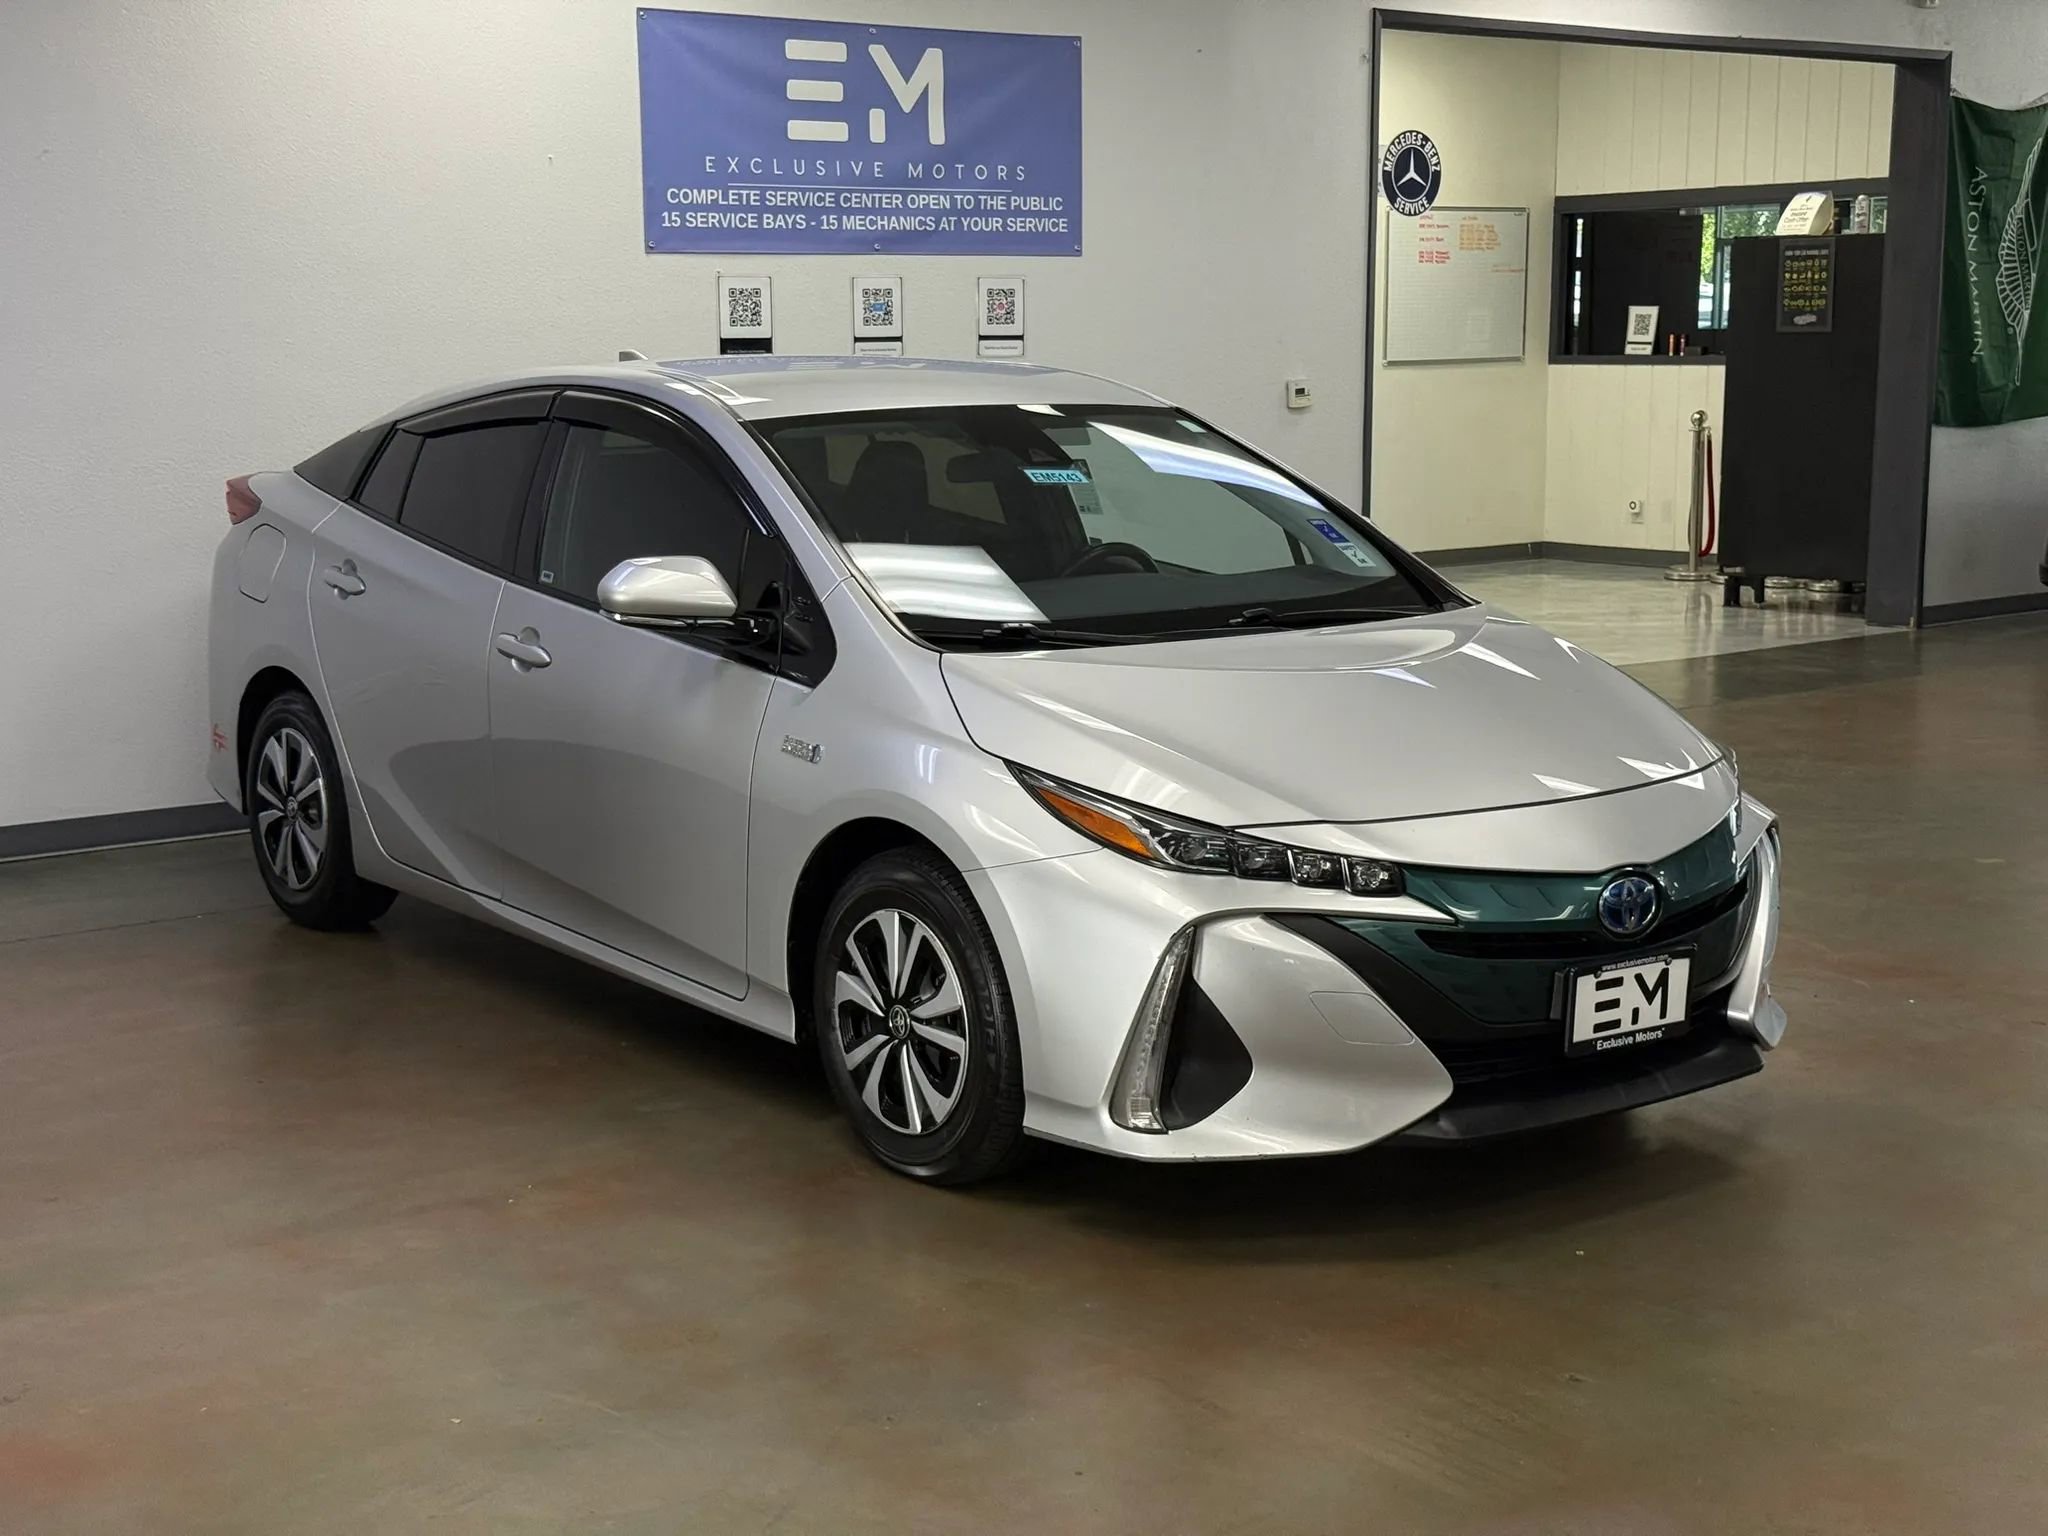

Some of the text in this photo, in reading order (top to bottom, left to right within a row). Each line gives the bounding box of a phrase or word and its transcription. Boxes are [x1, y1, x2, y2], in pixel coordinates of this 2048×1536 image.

[1383, 132, 1441, 172] MERCEDES-BENZ
[705, 156, 1025, 181] EXCLUSIVE MOTORS
[666, 188, 1064, 211] COMPLETE SERVICE CENTER OPEN TO THE PUBLIC
[1394, 197, 1429, 215] SERVICE
[661, 211, 681, 228] 15
[685, 212, 759, 229] SERVICE
[763, 214, 807, 229] BAYS
[820, 215, 838, 230] 15
[842, 215, 936, 231] MECHANICS
[939, 217, 957, 231] AT
[961, 217, 1003, 232] YOUR
[1007, 217, 1069, 233] SERVICE
[1967, 166, 1989, 356] ASTON MARTIN
[1031, 472, 1083, 482] EM5143
[1597, 1035, 1634, 1050] Exclusive
